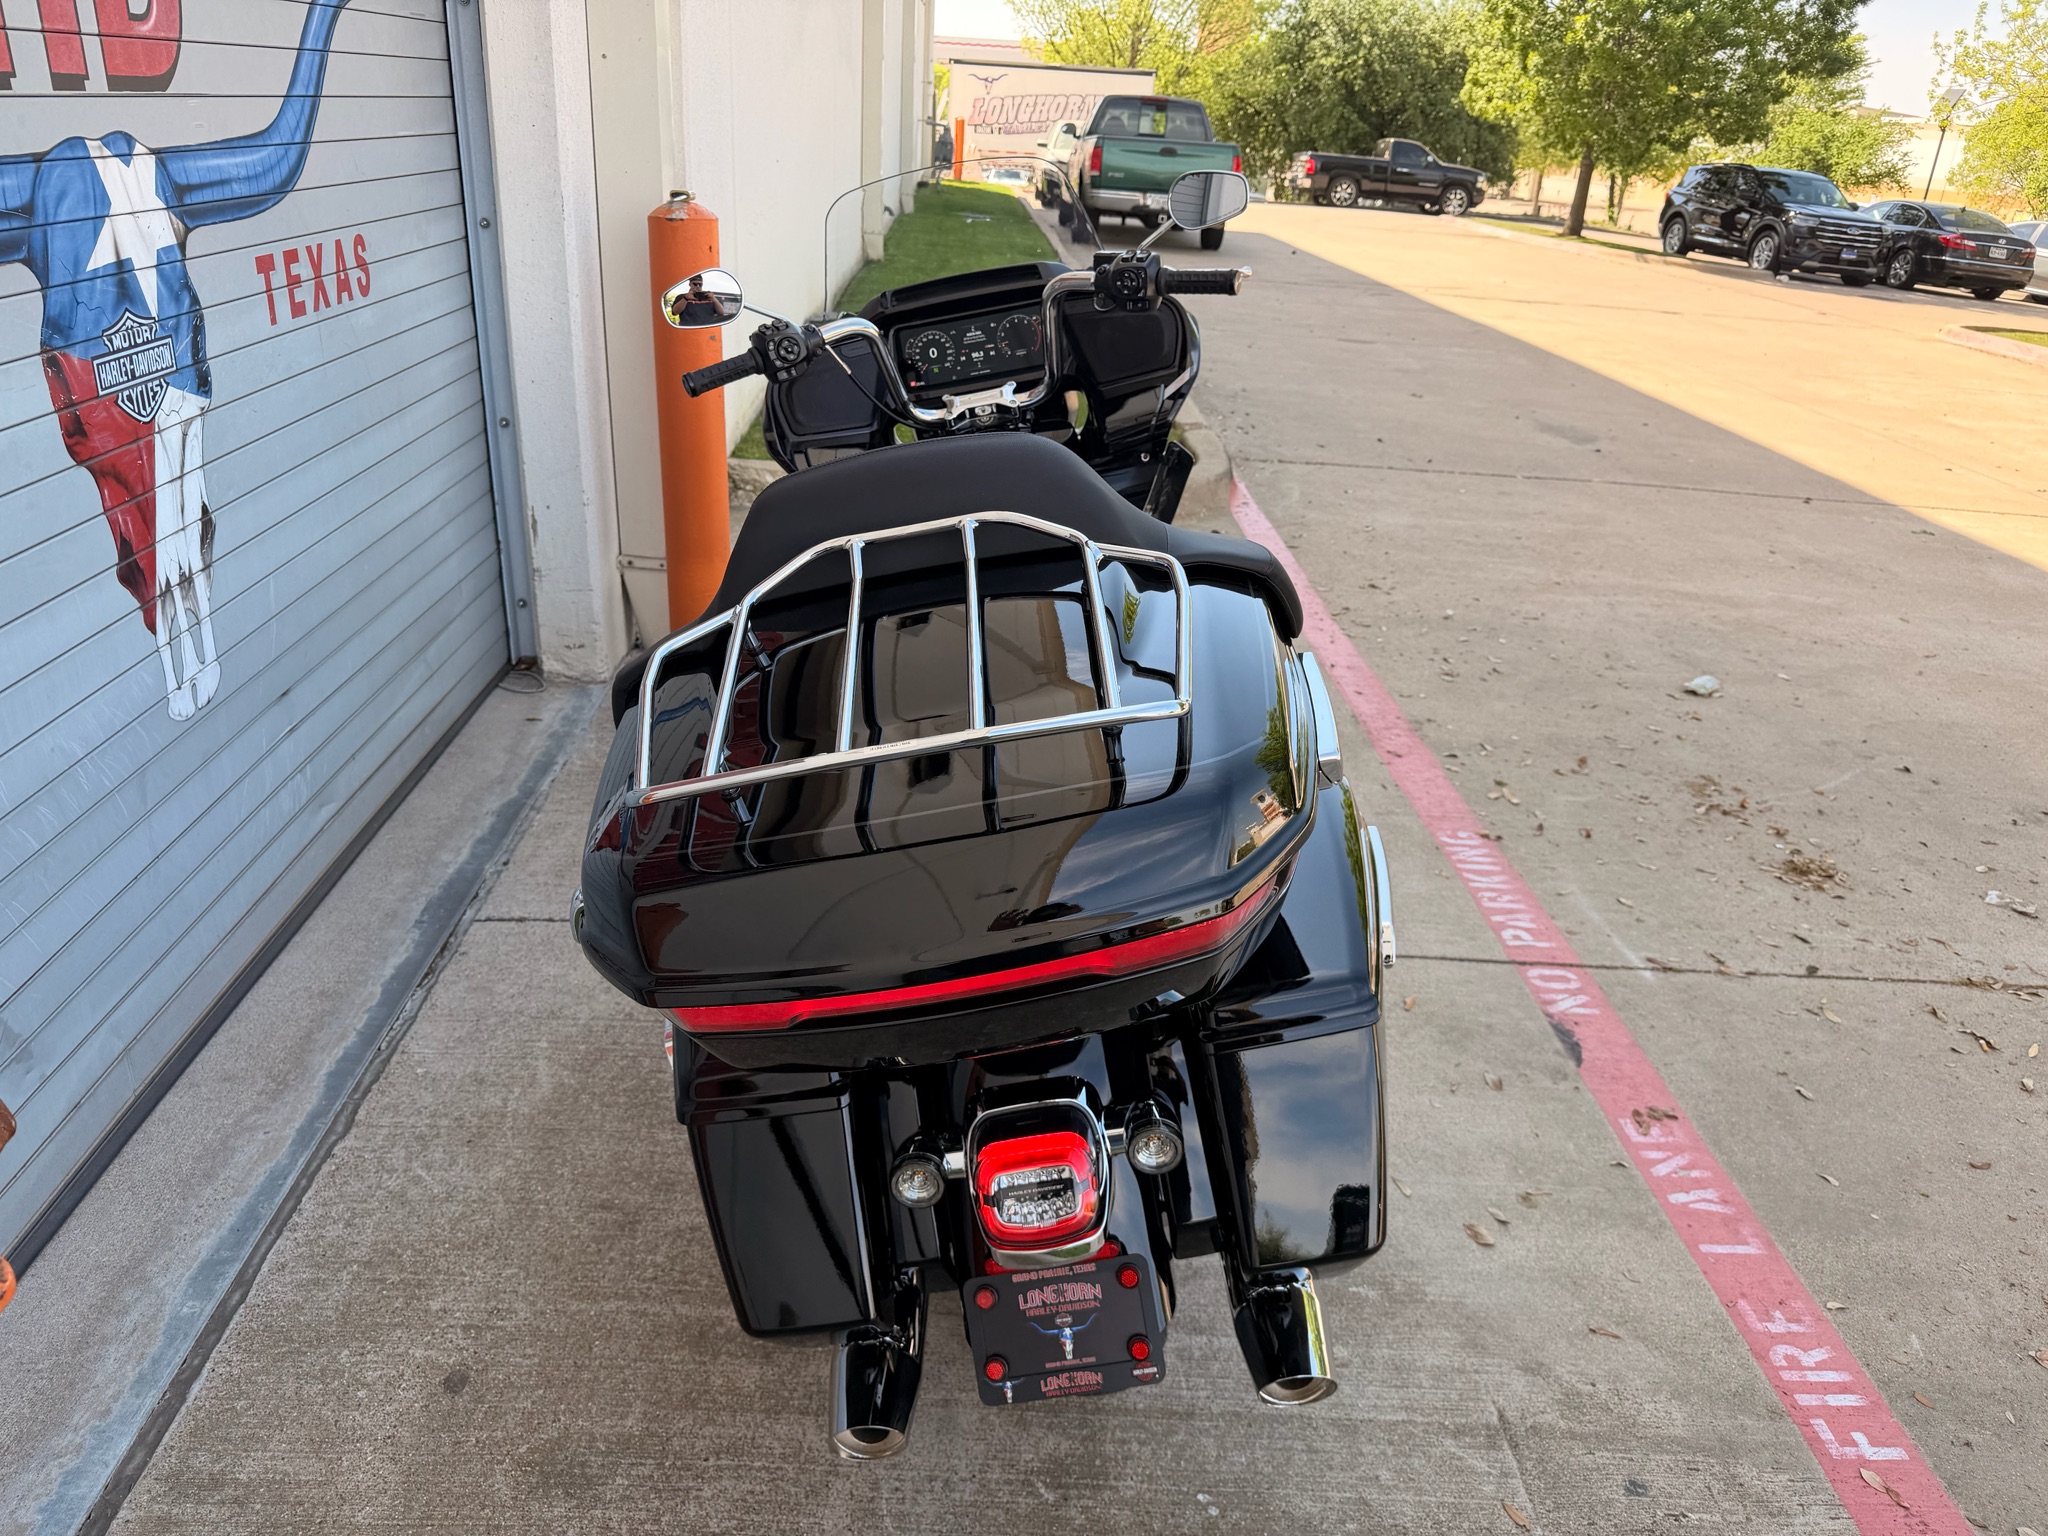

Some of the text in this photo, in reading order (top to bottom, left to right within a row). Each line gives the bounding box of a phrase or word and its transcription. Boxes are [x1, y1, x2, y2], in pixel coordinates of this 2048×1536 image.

[255, 233, 371, 326] TEXAS
[111, 324, 152, 351] MOTOR
[98, 342, 173, 389] HARLEY-DAVIDSON
[929, 347, 938, 358] 0
[122, 379, 161, 417] CYCLES
[1437, 831, 1910, 1461] FIRE LANE NO PARKING
[1072, 1262, 1097, 1274] TEXAS
[1018, 1282, 1102, 1310] LONGHORN
[1026, 1300, 1101, 1317] HARLEY-DAVIDSON
[1040, 1370, 1103, 1392] LONGHORN
